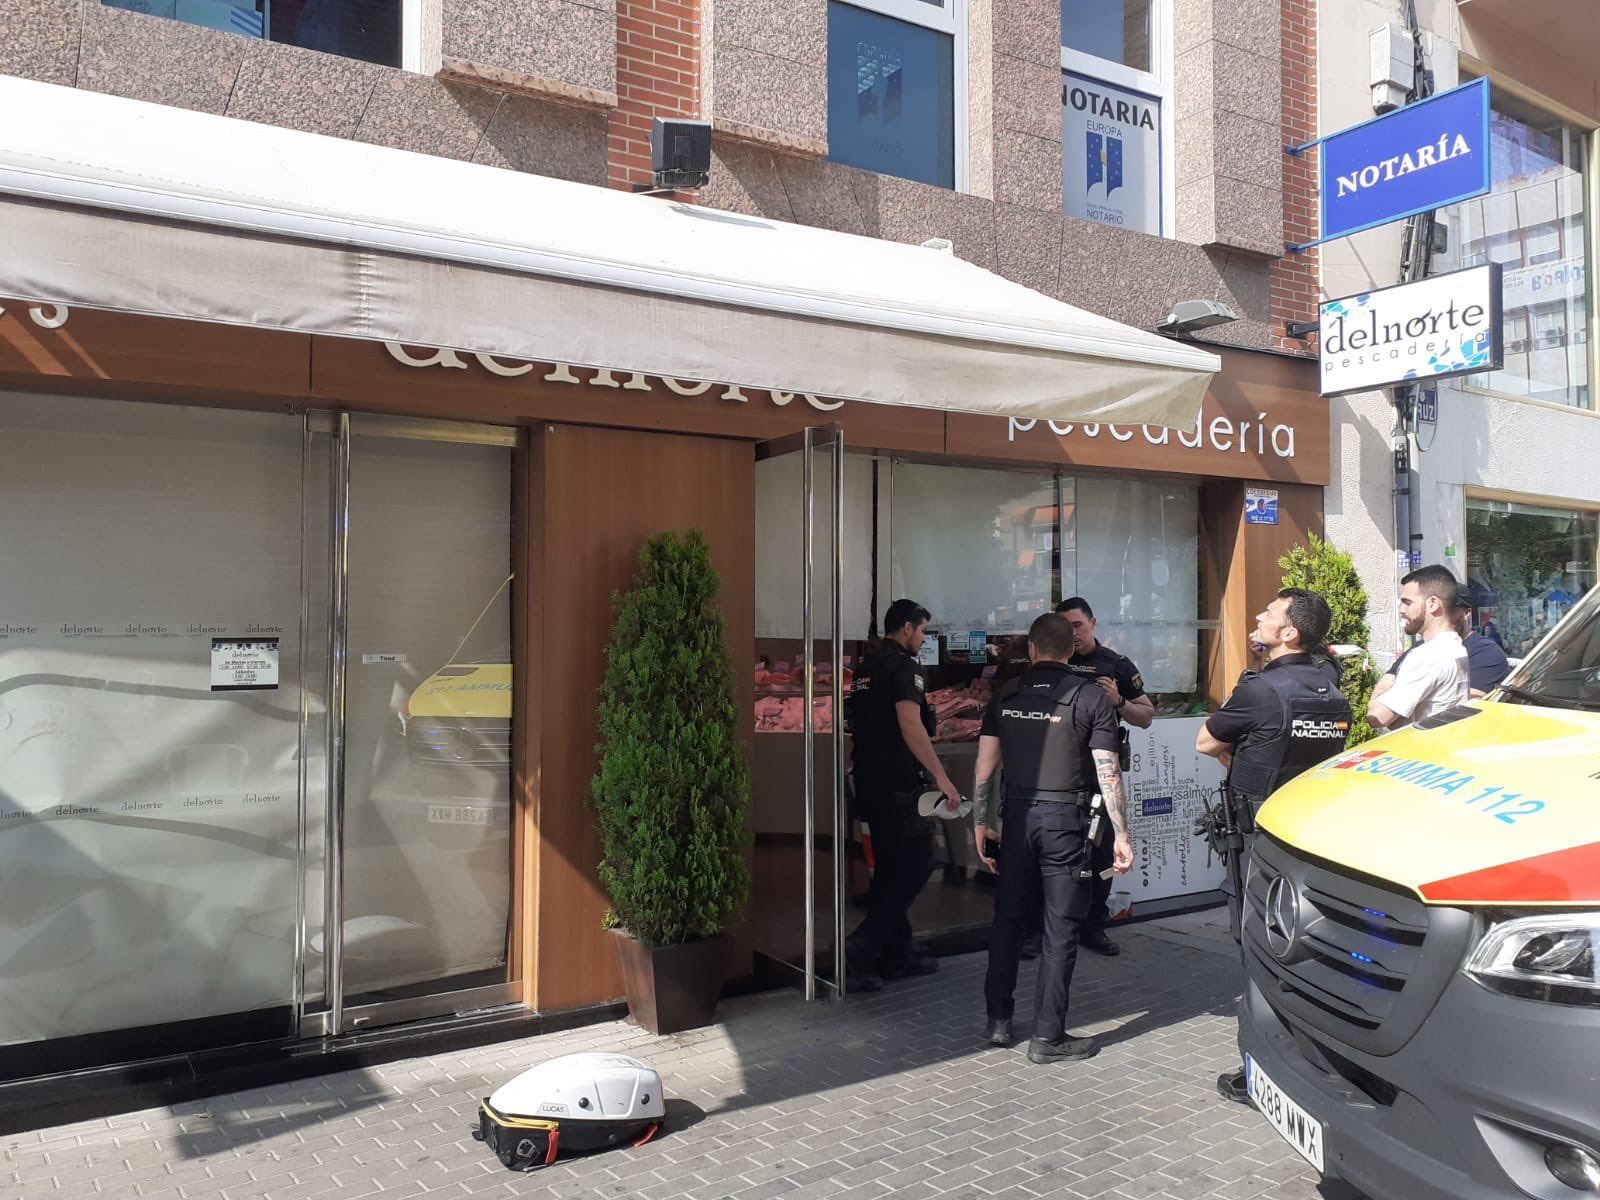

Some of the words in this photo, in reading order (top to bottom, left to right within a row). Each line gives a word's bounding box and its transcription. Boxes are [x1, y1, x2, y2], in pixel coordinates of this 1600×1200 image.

[1086, 119, 1123, 138] EUROPA
[1336, 133, 1472, 198] NOTARÍA
[1086, 208, 1124, 225] NOTARIO
[1325, 299, 1485, 355] delnorte
[60, 624, 104, 634] delnorte
[125, 624, 167, 634] delnorte
[186, 624, 227, 634] delnorte
[245, 624, 284, 634] delnorte
[1002, 709, 1051, 720] POLICIA
[1292, 720, 1338, 730] POLICIA
[1291, 729, 1346, 739] NACIONAL
[1177, 785, 1213, 801] salmón
[1356, 756, 1475, 796] SUMMA
[1464, 785, 1546, 825] 112
[183, 797, 223, 808] delnorte
[242, 794, 281, 804] delnorte
[56, 805, 99, 816] delnorte
[121, 801, 163, 812] delnorte
[1143, 801, 1172, 812] delnorte
[542, 1104, 565, 1113] LUCAS
[1255, 1070, 1282, 1125] 4288
[1286, 1102, 1318, 1161] MWX
